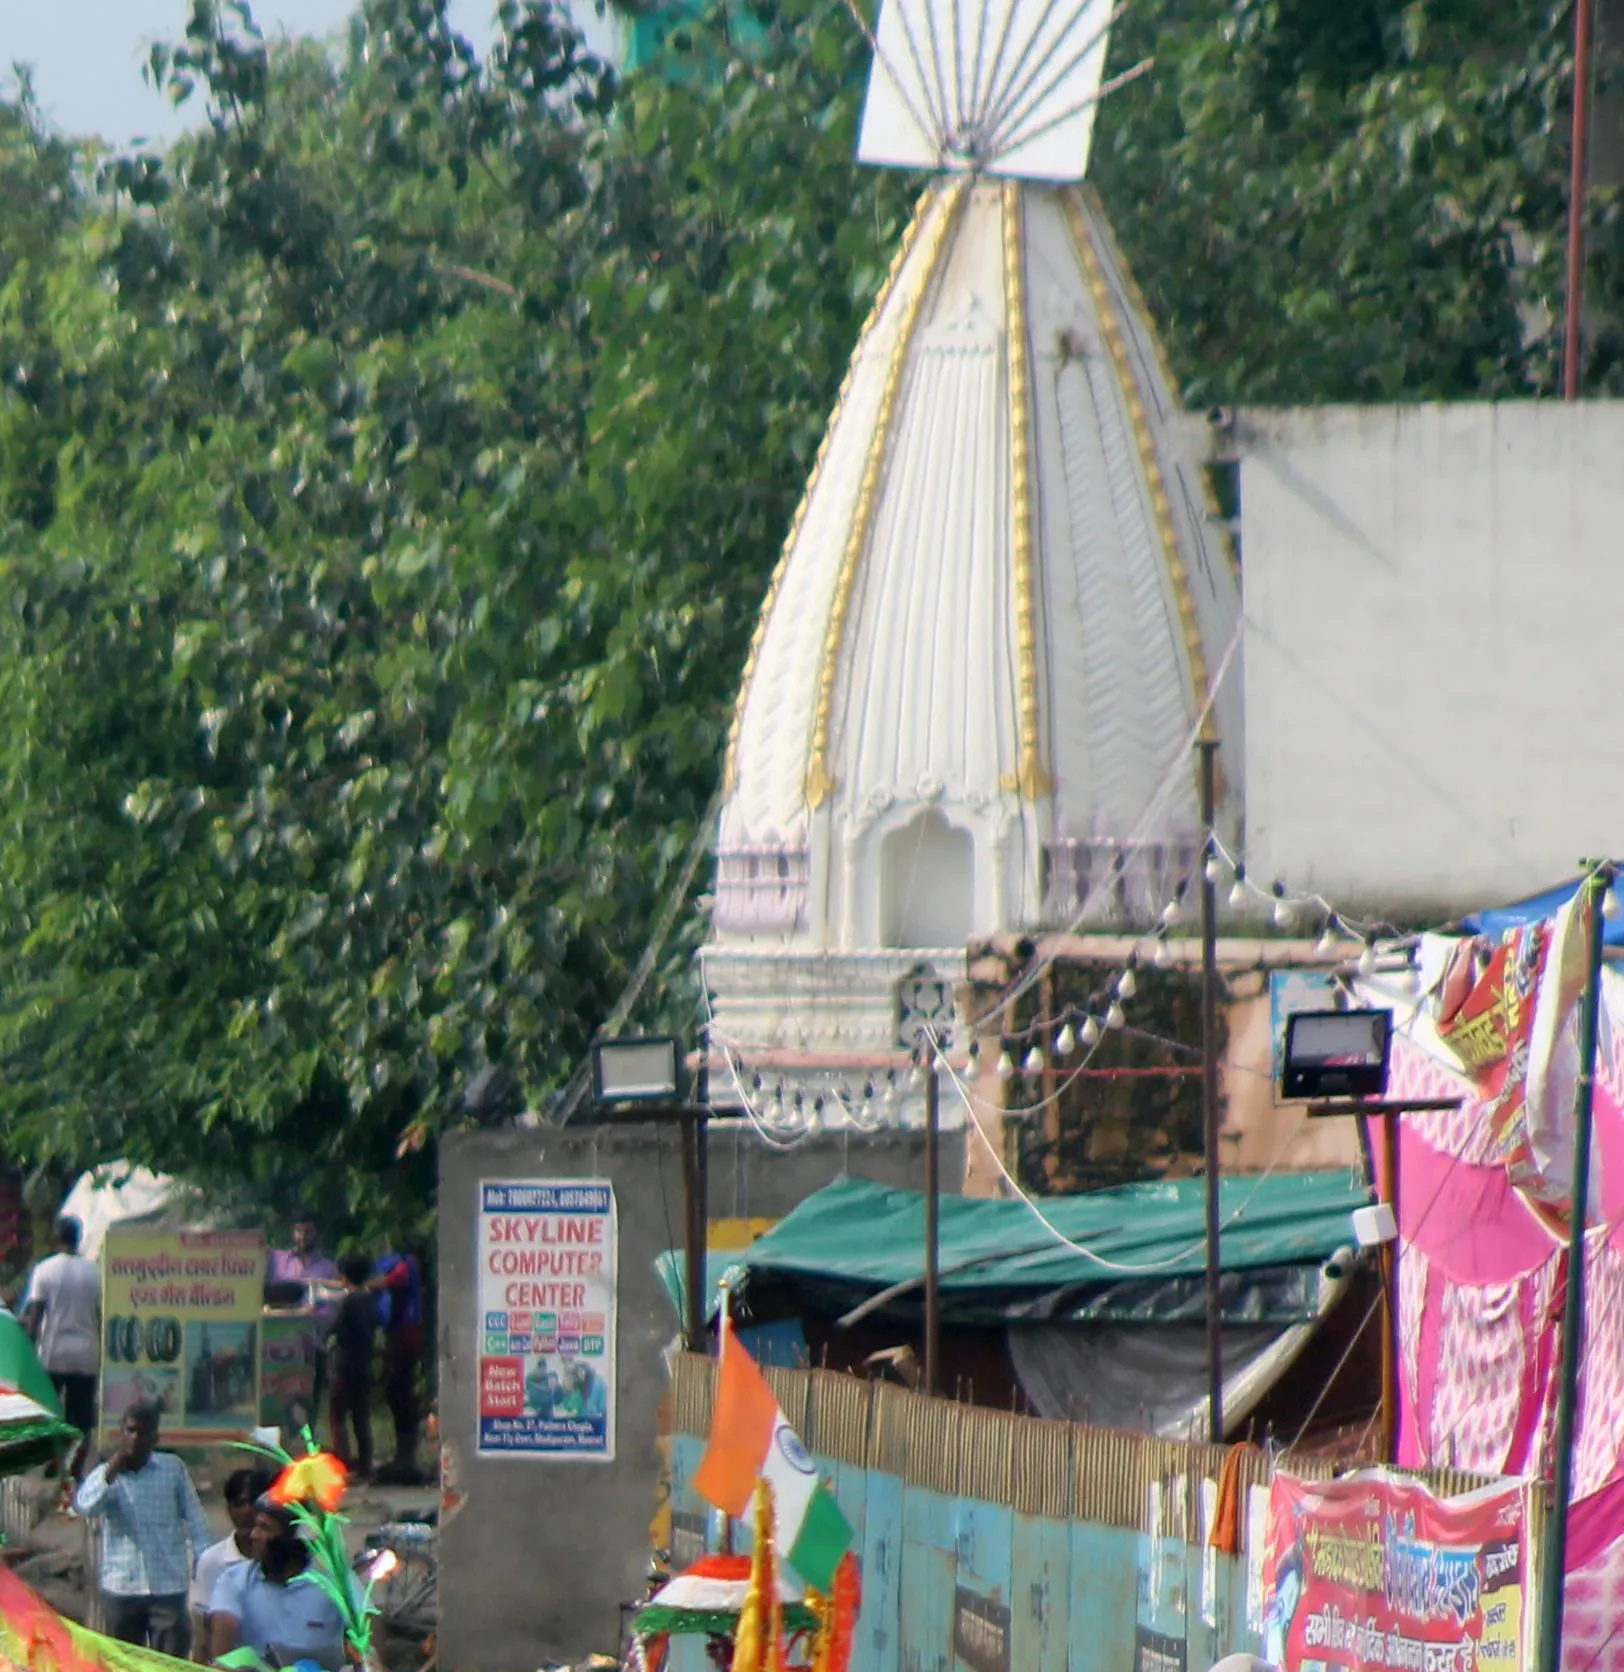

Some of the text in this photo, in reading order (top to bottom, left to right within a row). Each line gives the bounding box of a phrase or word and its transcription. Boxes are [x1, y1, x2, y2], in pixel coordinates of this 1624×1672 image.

[489, 1216, 604, 1244] SKYLINE
[488, 1248, 603, 1277] COMPUTER
[504, 1281, 586, 1308] CENTER
[488, 1365, 517, 1377] New
[485, 1379, 521, 1392] Batch
[487, 1393, 517, 1406] Start
